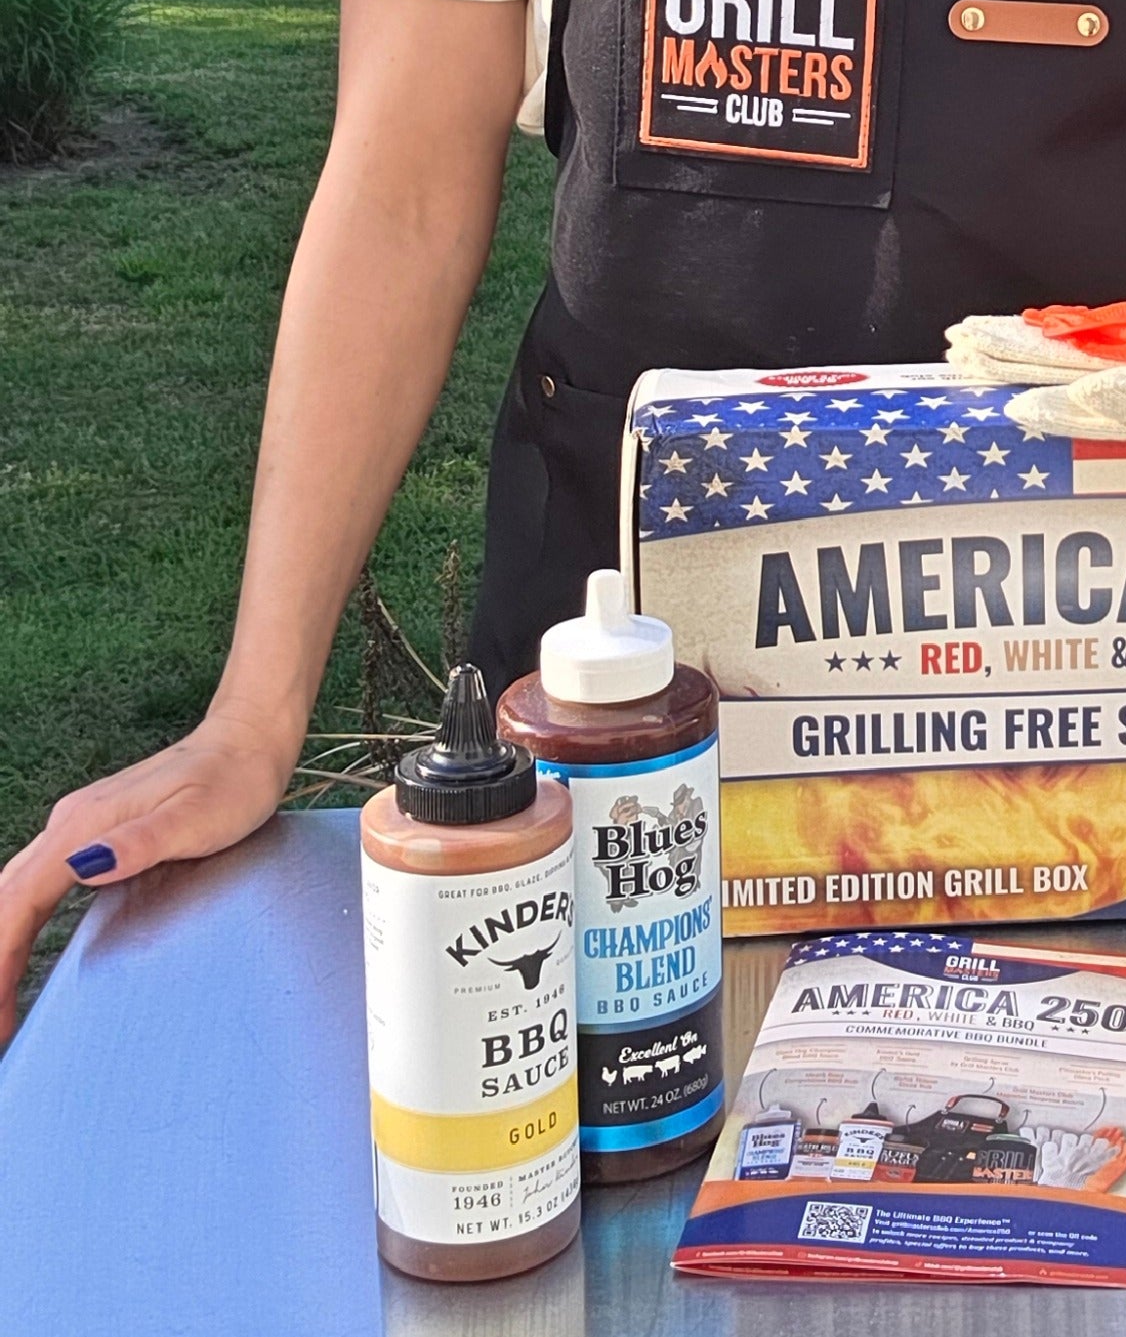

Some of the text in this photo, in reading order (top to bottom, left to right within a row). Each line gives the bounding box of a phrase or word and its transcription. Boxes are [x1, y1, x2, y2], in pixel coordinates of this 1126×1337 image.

[726, 94, 783, 127] CLUB
[920, 641, 991, 678] RED,
[1003, 638, 1099, 673] WHITE
[792, 710, 987, 758] GRILLING
[1005, 707, 1100, 750] FREE
[592, 811, 708, 861] Blues
[439, 889, 467, 899] GREAT
[471, 887, 489, 898] FOR
[606, 854, 698, 900] Hog
[722, 863, 1089, 907] IMITED EDITION GRILL BOX
[616, 945, 695, 993] BLEND
[945, 955, 1000, 972] GRILL
[454, 983, 501, 994] PREMIUM
[488, 984, 565, 1022] EST. 1946
[597, 971, 708, 1014] BBQ SAUCE
[791, 983, 1019, 1017] AMERICA
[845, 1024, 1049, 1048] COMMEMORATIVE BBQ BUNDLE
[883, 1009, 1035, 1031] RED, WHITE & BBQ
[481, 1008, 568, 1068] BBQ
[618, 1030, 698, 1063] Excellent On
[481, 1045, 569, 1098] SAUCE
[603, 1100, 626, 1115] NET
[627, 1097, 649, 1112] WT.
[651, 1094, 663, 1109] 24
[509, 1111, 557, 1145] GOLD
[452, 1181, 504, 1193] FOUNDED
[454, 1193, 501, 1210] 1946
[457, 1222, 483, 1235] NET
[490, 1217, 513, 1231] WT.
[546, 1196, 558, 1212] OZ
[876, 1209, 891, 1218] The
[893, 1211, 931, 1222] Ultimate
[933, 1214, 953, 1224] BBQ
